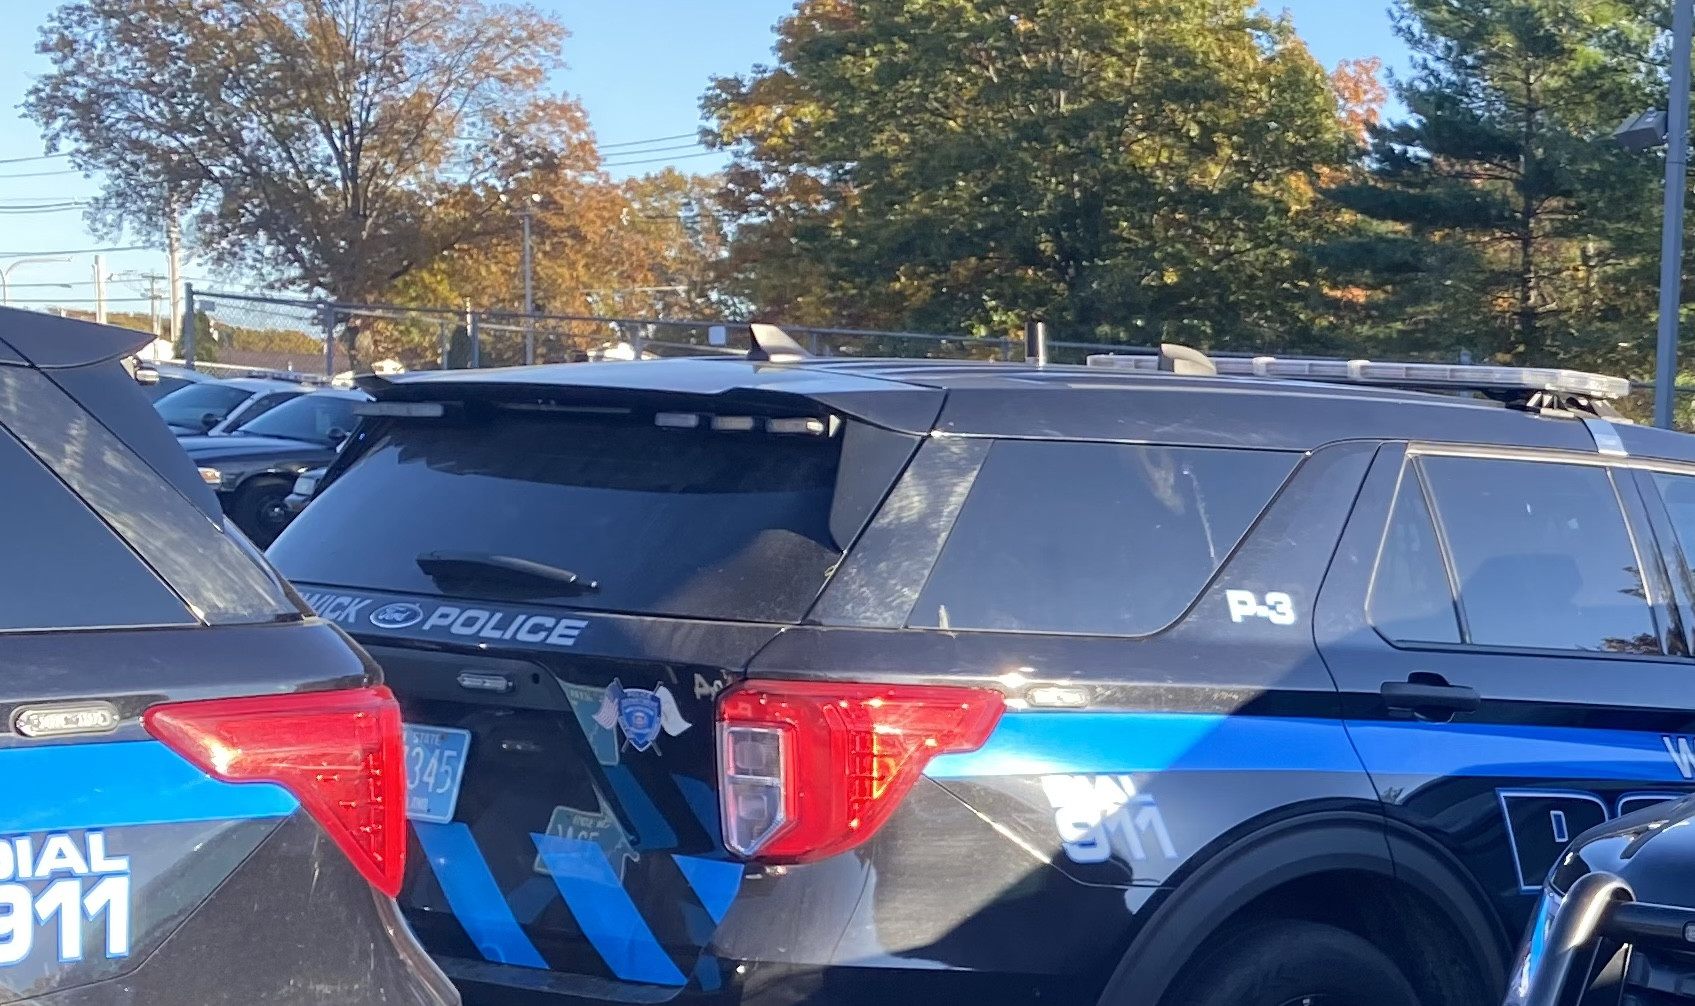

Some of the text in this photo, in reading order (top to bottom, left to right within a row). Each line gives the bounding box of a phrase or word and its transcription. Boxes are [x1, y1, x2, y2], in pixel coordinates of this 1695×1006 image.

[421, 605, 589, 646] POLICE
[1225, 589, 1296, 625] P-3
[404, 746, 457, 794] 345
[1054, 805, 1178, 864] 911
